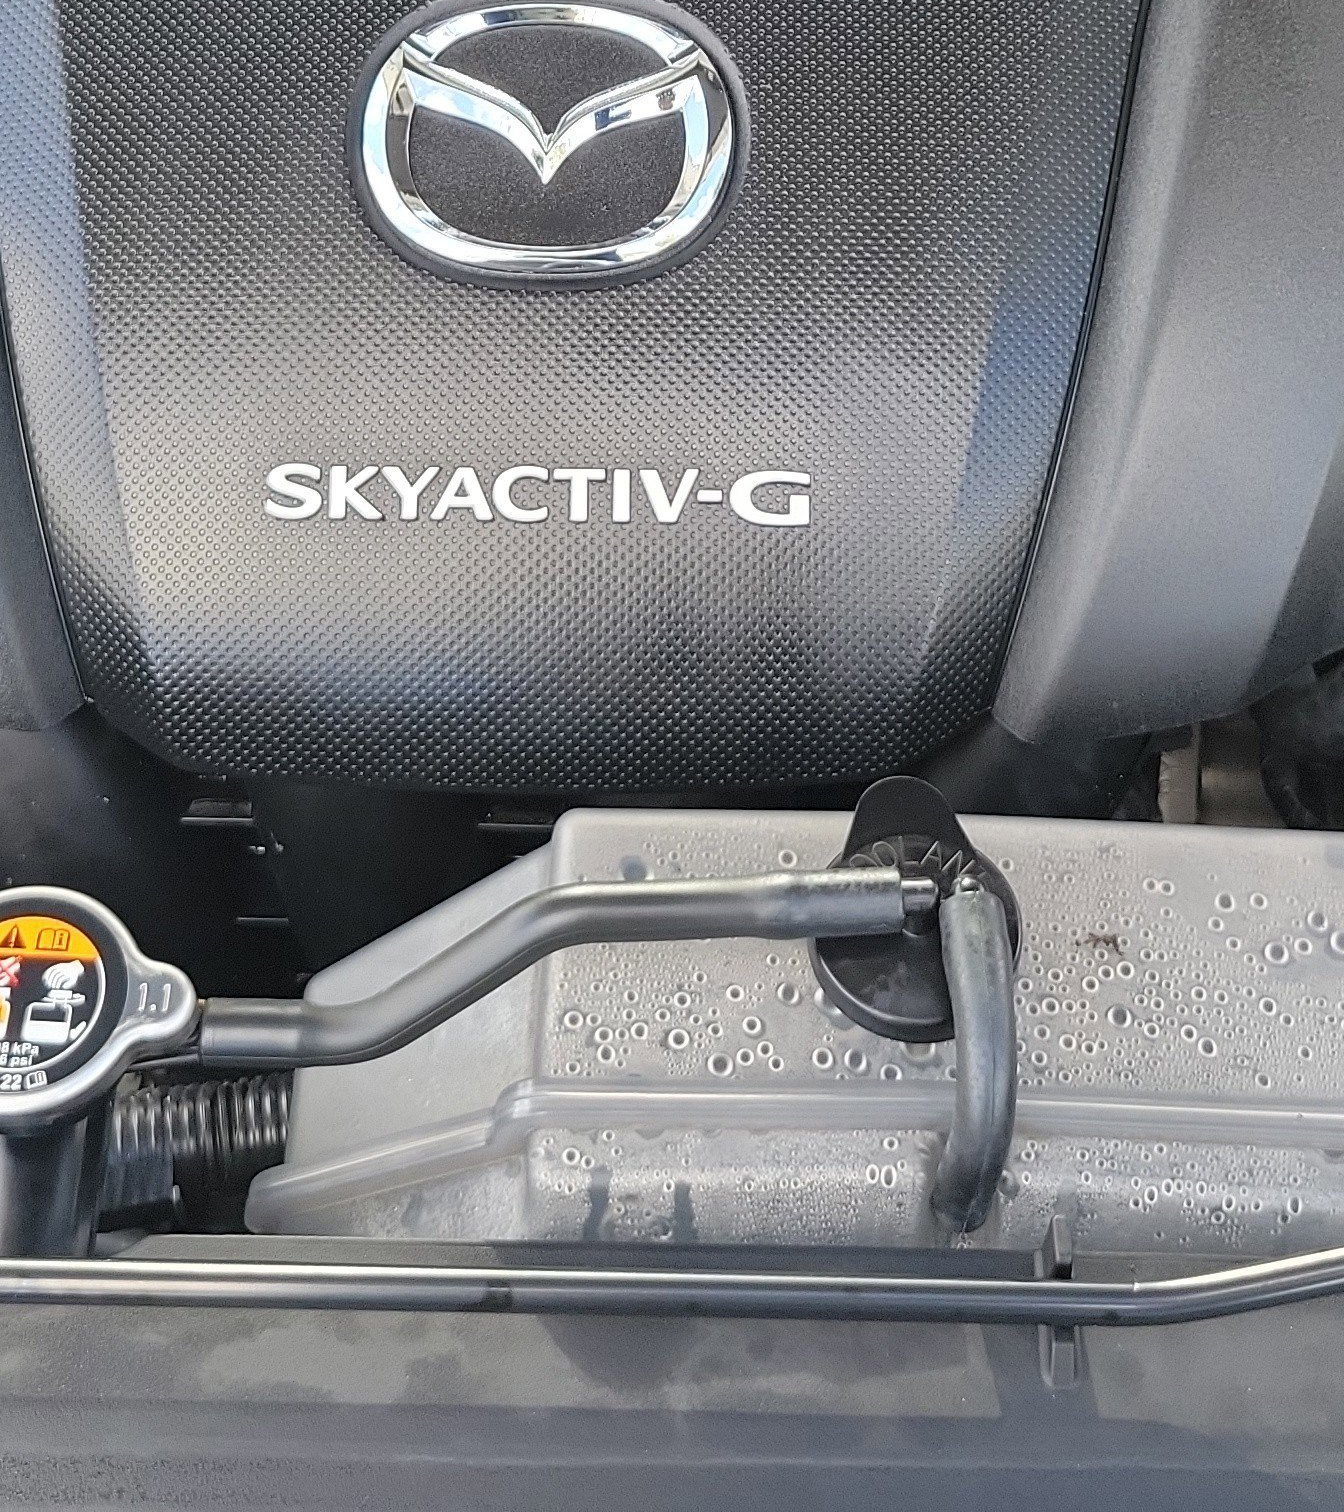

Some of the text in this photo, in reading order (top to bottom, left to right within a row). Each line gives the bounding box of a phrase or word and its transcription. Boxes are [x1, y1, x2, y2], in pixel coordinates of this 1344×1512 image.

[263, 462, 813, 528] SKYACTIV-G
[136, 982, 172, 1012] 1.1
[11, 1041, 40, 1057] kPa
[8, 1054, 33, 1068] psi
